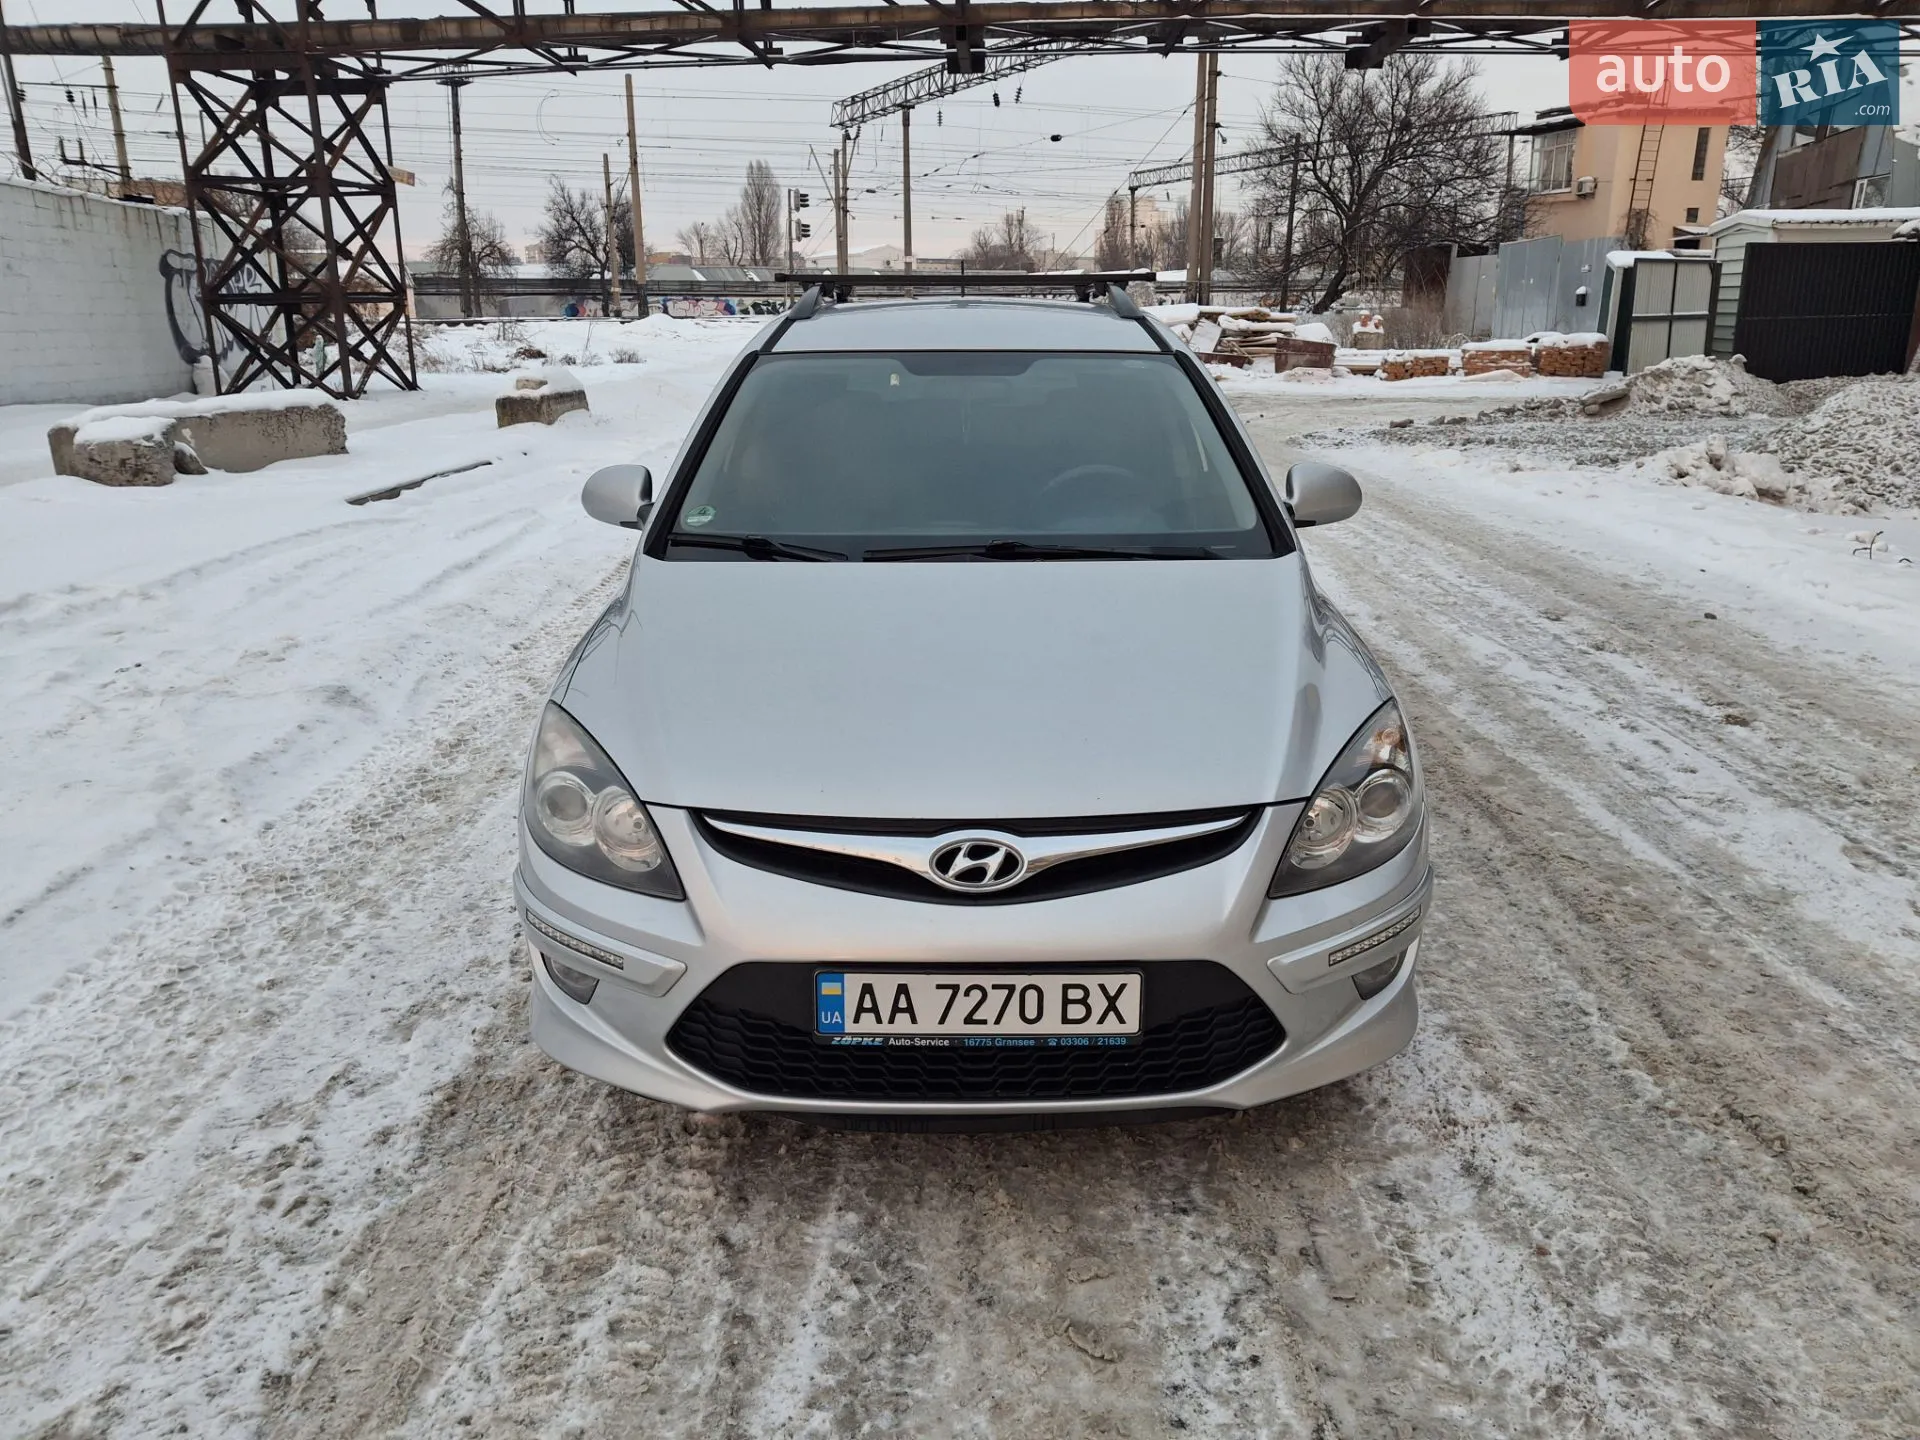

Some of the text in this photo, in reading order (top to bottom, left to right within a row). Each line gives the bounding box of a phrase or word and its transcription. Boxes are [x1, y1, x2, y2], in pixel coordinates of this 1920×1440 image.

[852, 983, 1128, 1025] AA 7270 BX
[821, 1011, 842, 1024] UA
[888, 1037, 950, 1046] Auto-Service
[963, 1038, 992, 1046] 16775
[994, 1038, 1035, 1046] Gransee
[1060, 1037, 1089, 1046] 03306
[1097, 1037, 1127, 1046] 21639
